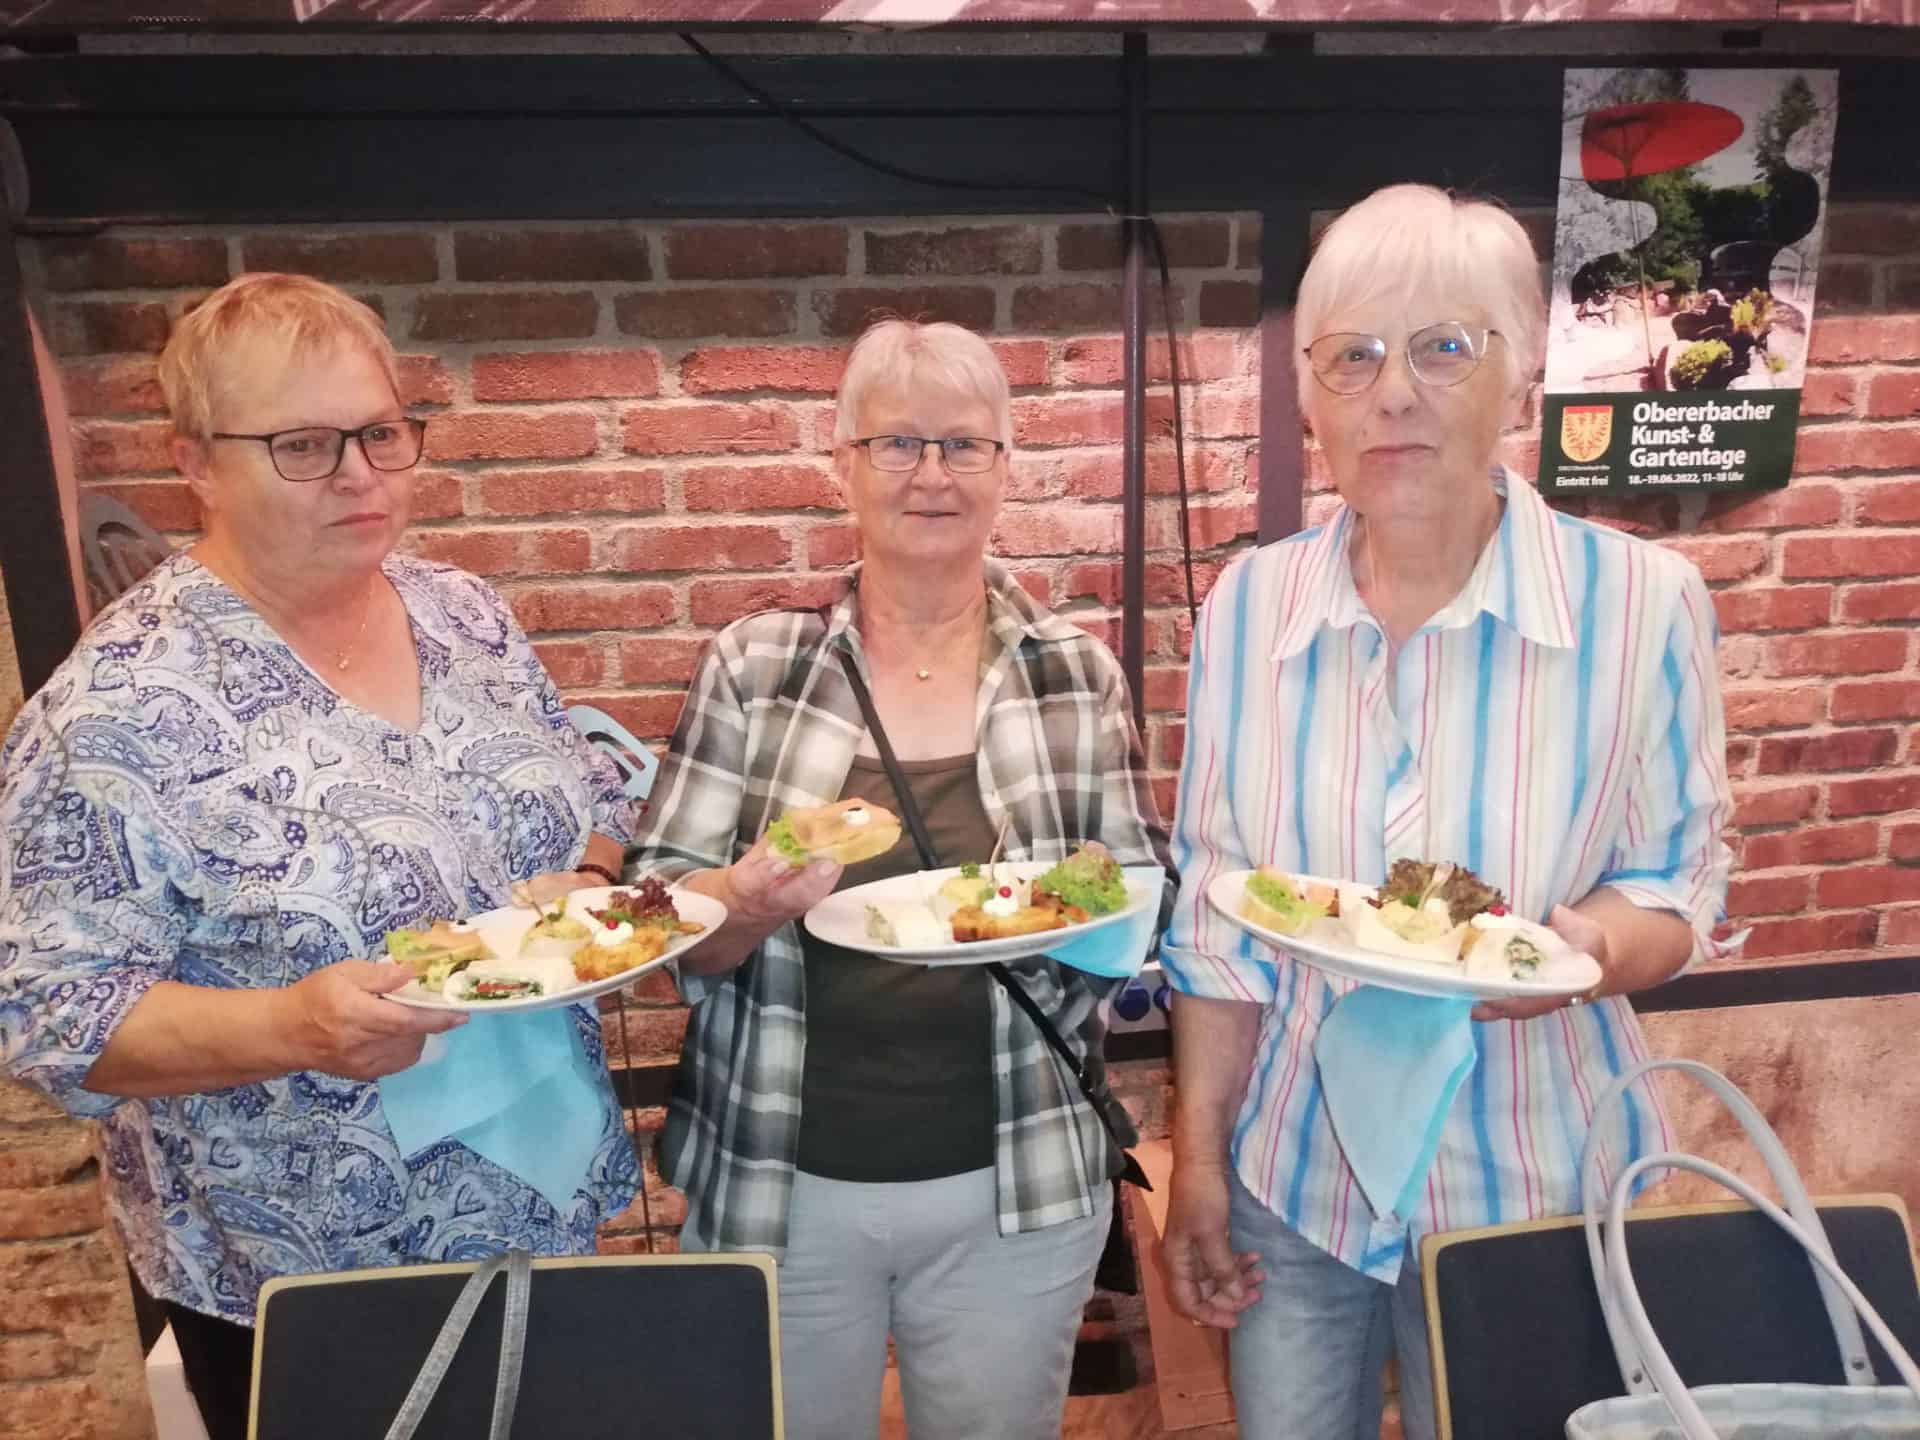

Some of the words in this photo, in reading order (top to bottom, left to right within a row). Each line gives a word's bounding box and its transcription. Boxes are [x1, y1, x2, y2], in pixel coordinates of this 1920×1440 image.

[1633, 400, 1775, 422] Obererbacher
[1631, 425, 1695, 445] Kunst-
[1698, 424, 1715, 443] &
[1629, 449, 1746, 469] Gartentage
[1556, 476, 1590, 486] Eintritt
[1591, 475, 1609, 486] frei
